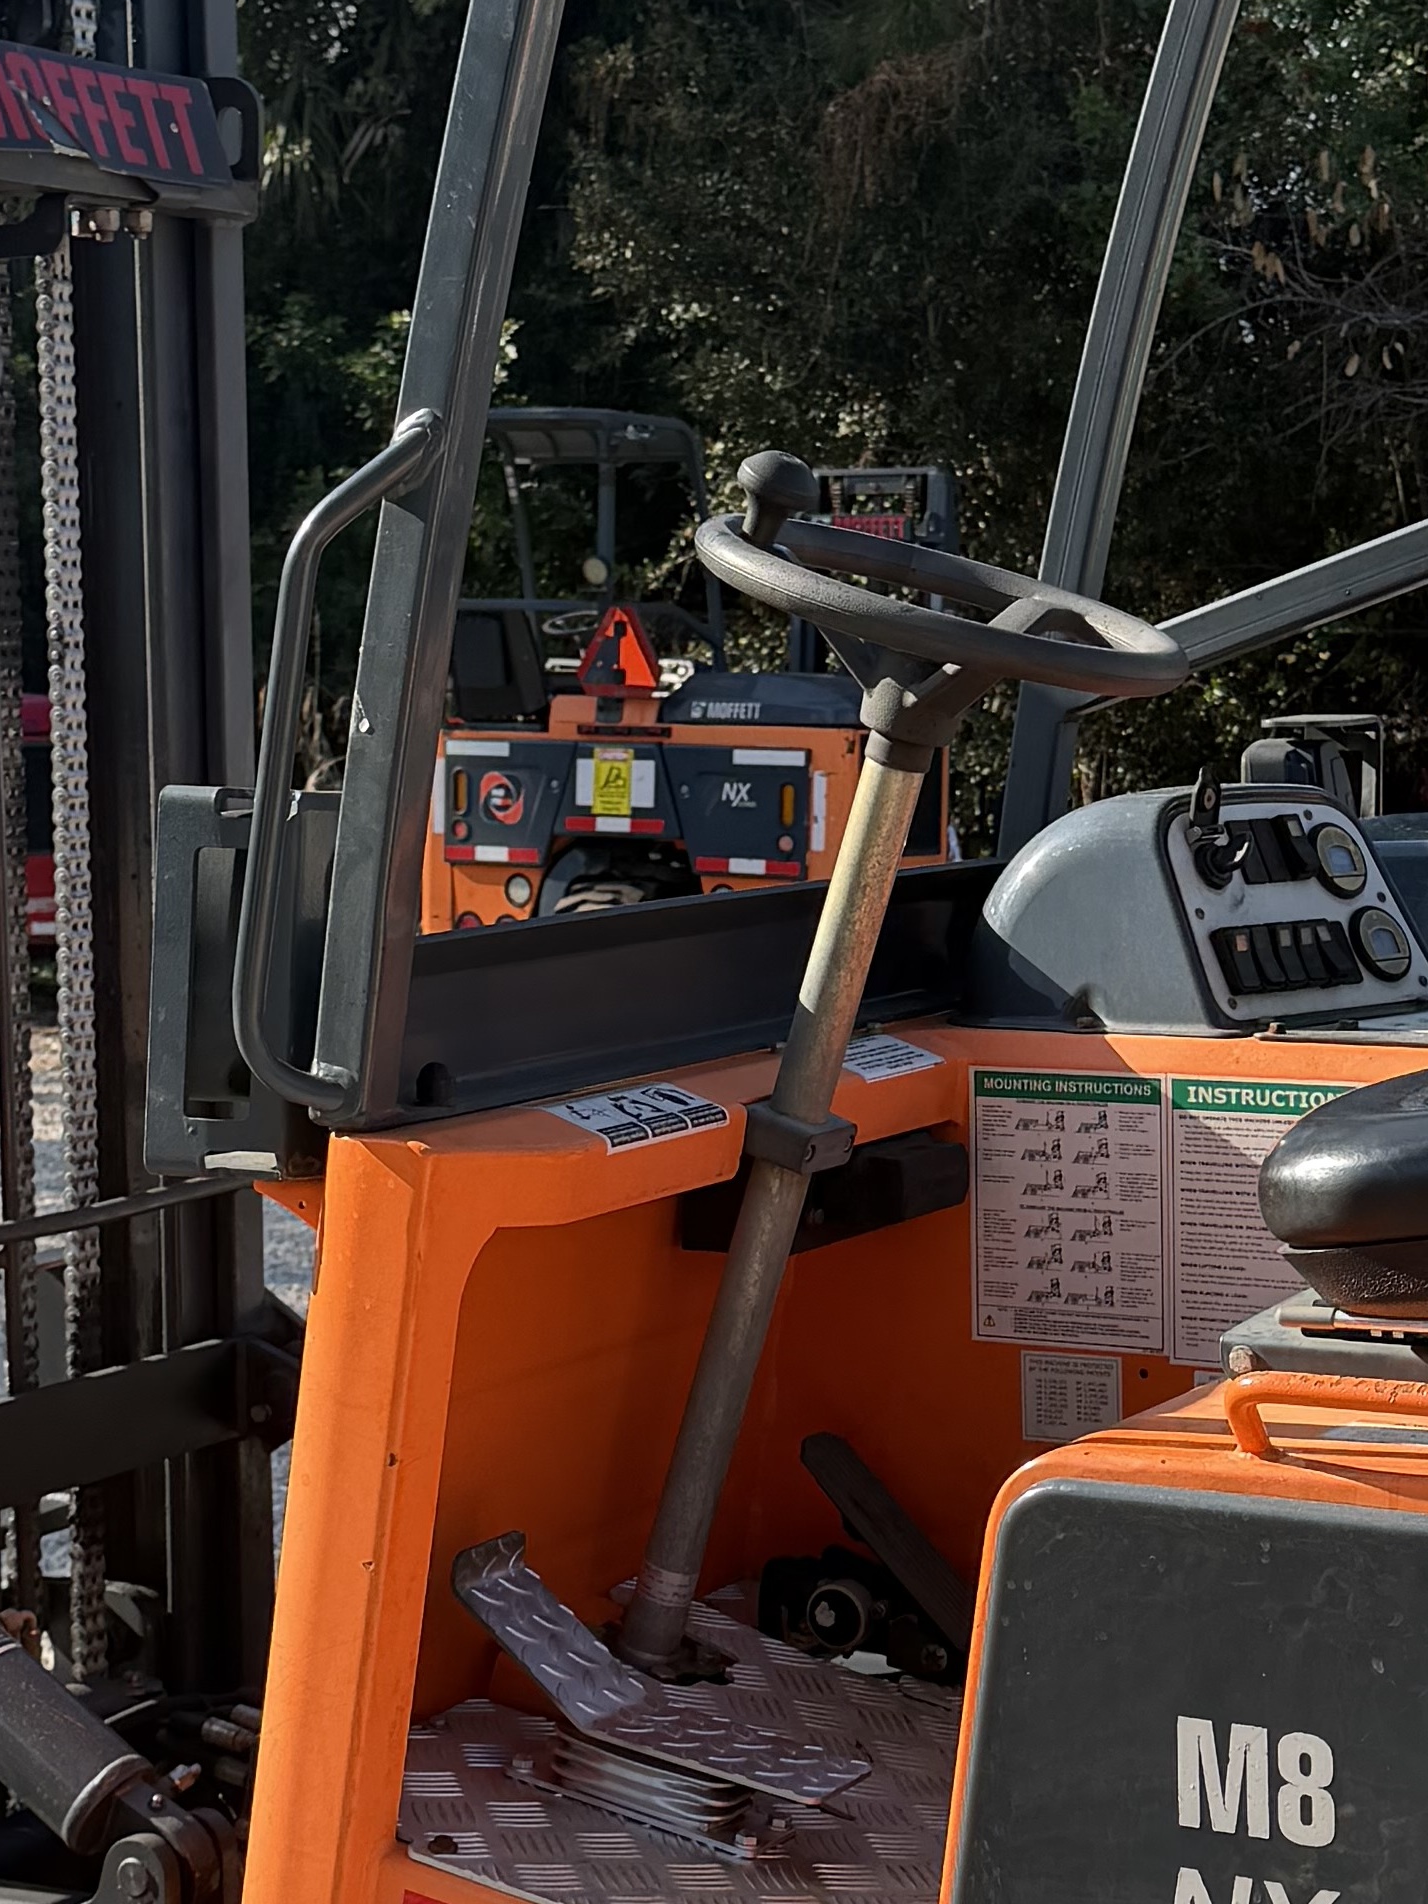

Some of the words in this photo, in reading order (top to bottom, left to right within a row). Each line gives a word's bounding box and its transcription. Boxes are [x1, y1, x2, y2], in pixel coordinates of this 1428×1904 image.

[721, 782, 751, 807] NX
[983, 1077, 1052, 1092] MOUNTING
[1055, 1080, 1152, 1096] INSTRUCTIONS
[1177, 1715, 1336, 1848] M8
